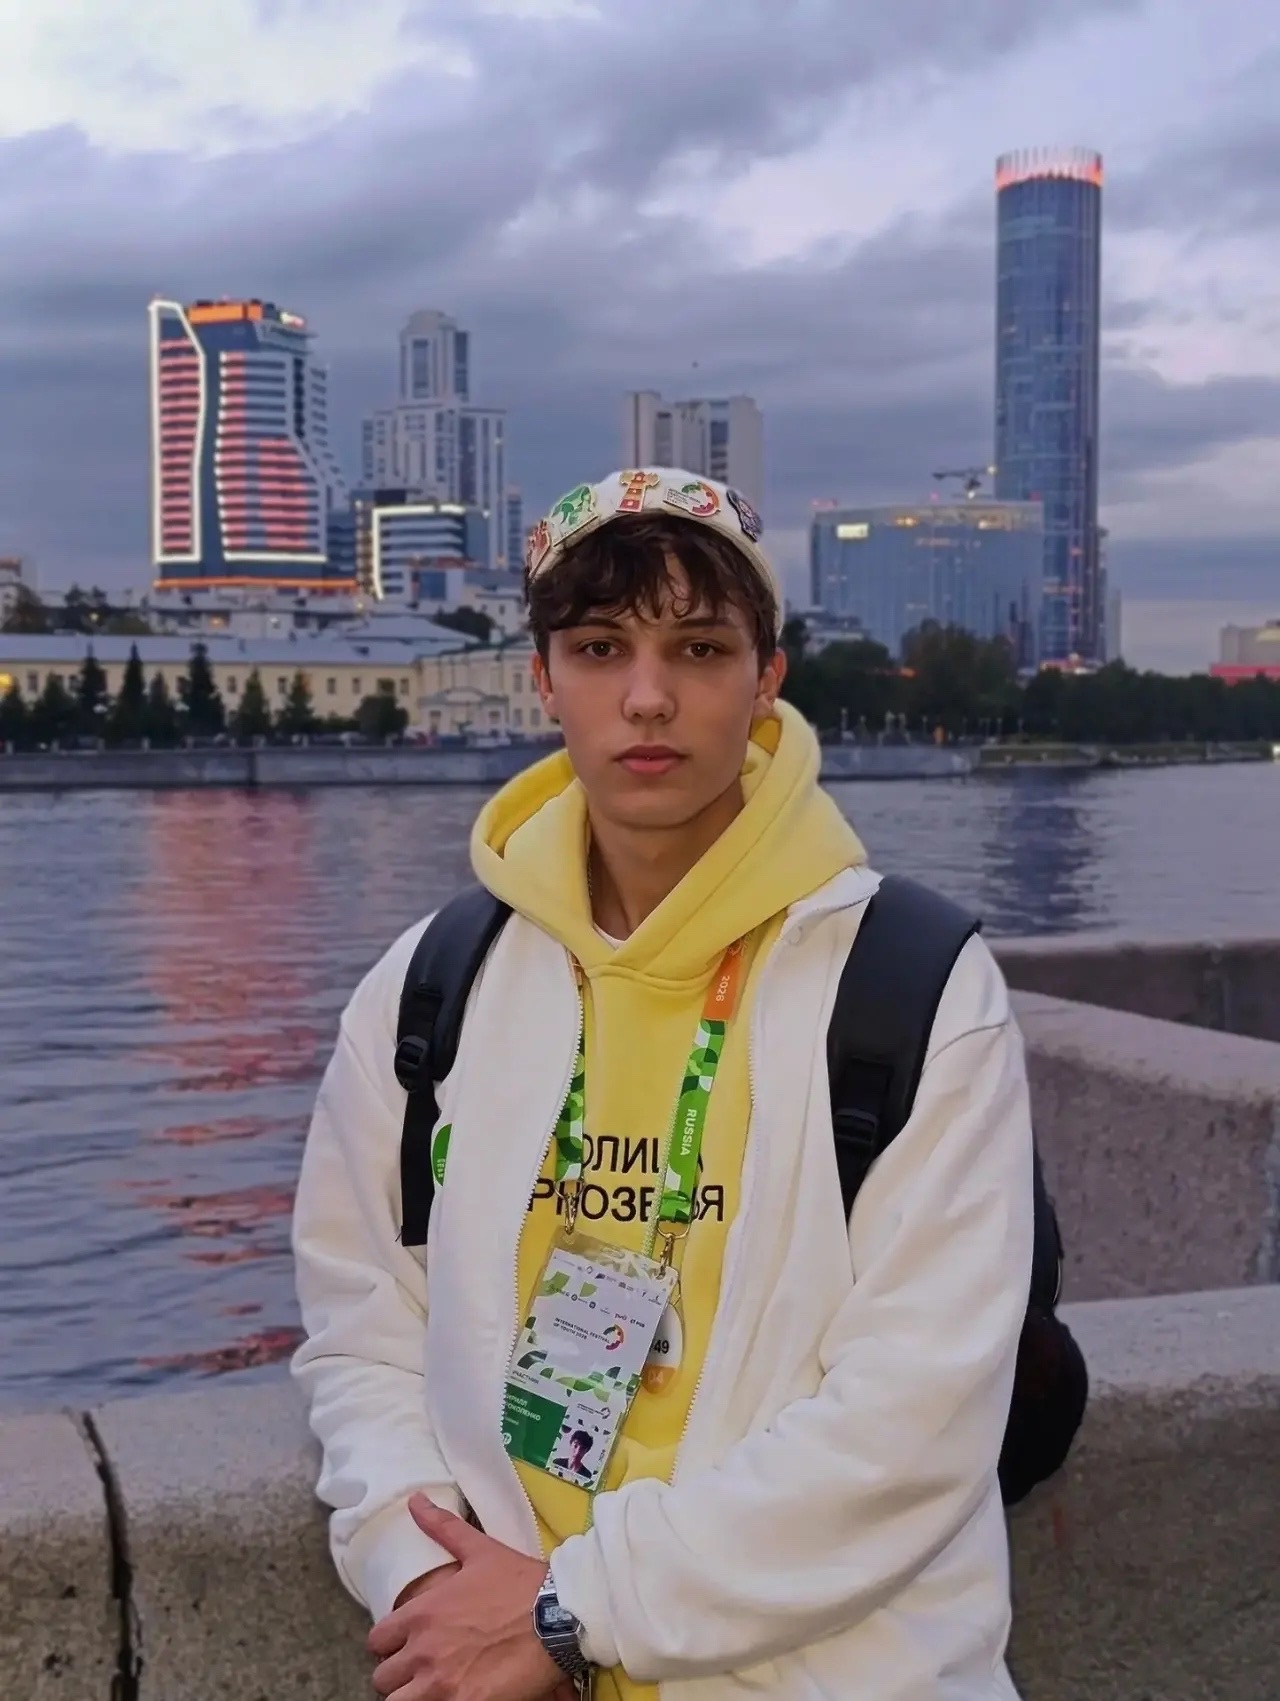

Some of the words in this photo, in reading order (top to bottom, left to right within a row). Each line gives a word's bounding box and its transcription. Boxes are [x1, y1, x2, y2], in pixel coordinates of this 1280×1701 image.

[716, 975, 730, 1002] 2026
[679, 1108, 697, 1156] RUSSIA
[555, 1317, 589, 1335] INTERNATIONAL
